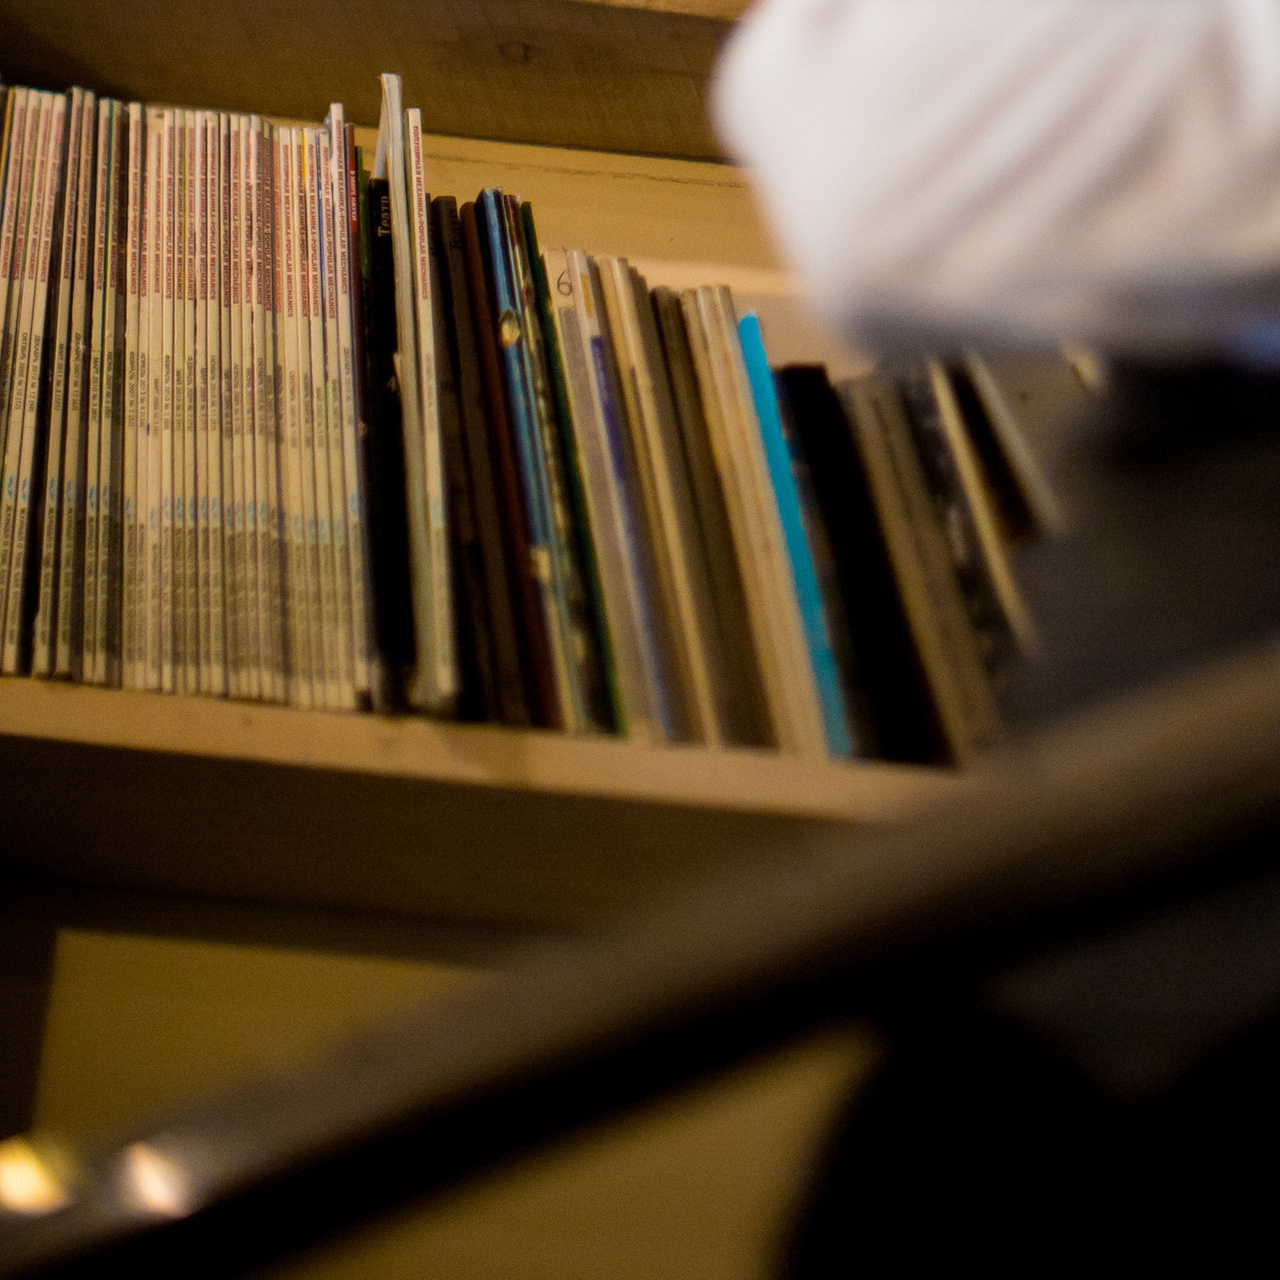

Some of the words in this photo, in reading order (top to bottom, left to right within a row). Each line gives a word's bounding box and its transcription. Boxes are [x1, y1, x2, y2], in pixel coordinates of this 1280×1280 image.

[96, 248, 105, 290] MECHANICS
[130, 252, 138, 295] MECHANICS
[154, 254, 162, 293] MECHANICS
[165, 258, 173, 299] MECHANICS
[176, 258, 184, 300] MECHANICS
[222, 265, 230, 308] MECHANICS
[264, 269, 272, 311] MECHANICS
[340, 252, 348, 294] MECHANICS
[420, 257, 429, 300] MECHANICS
[286, 275, 294, 317] MECHANICS
[300, 274, 308, 317] MECHANICS
[312, 274, 320, 317] MECHANICS
[327, 276, 336, 319] MECHANICS
